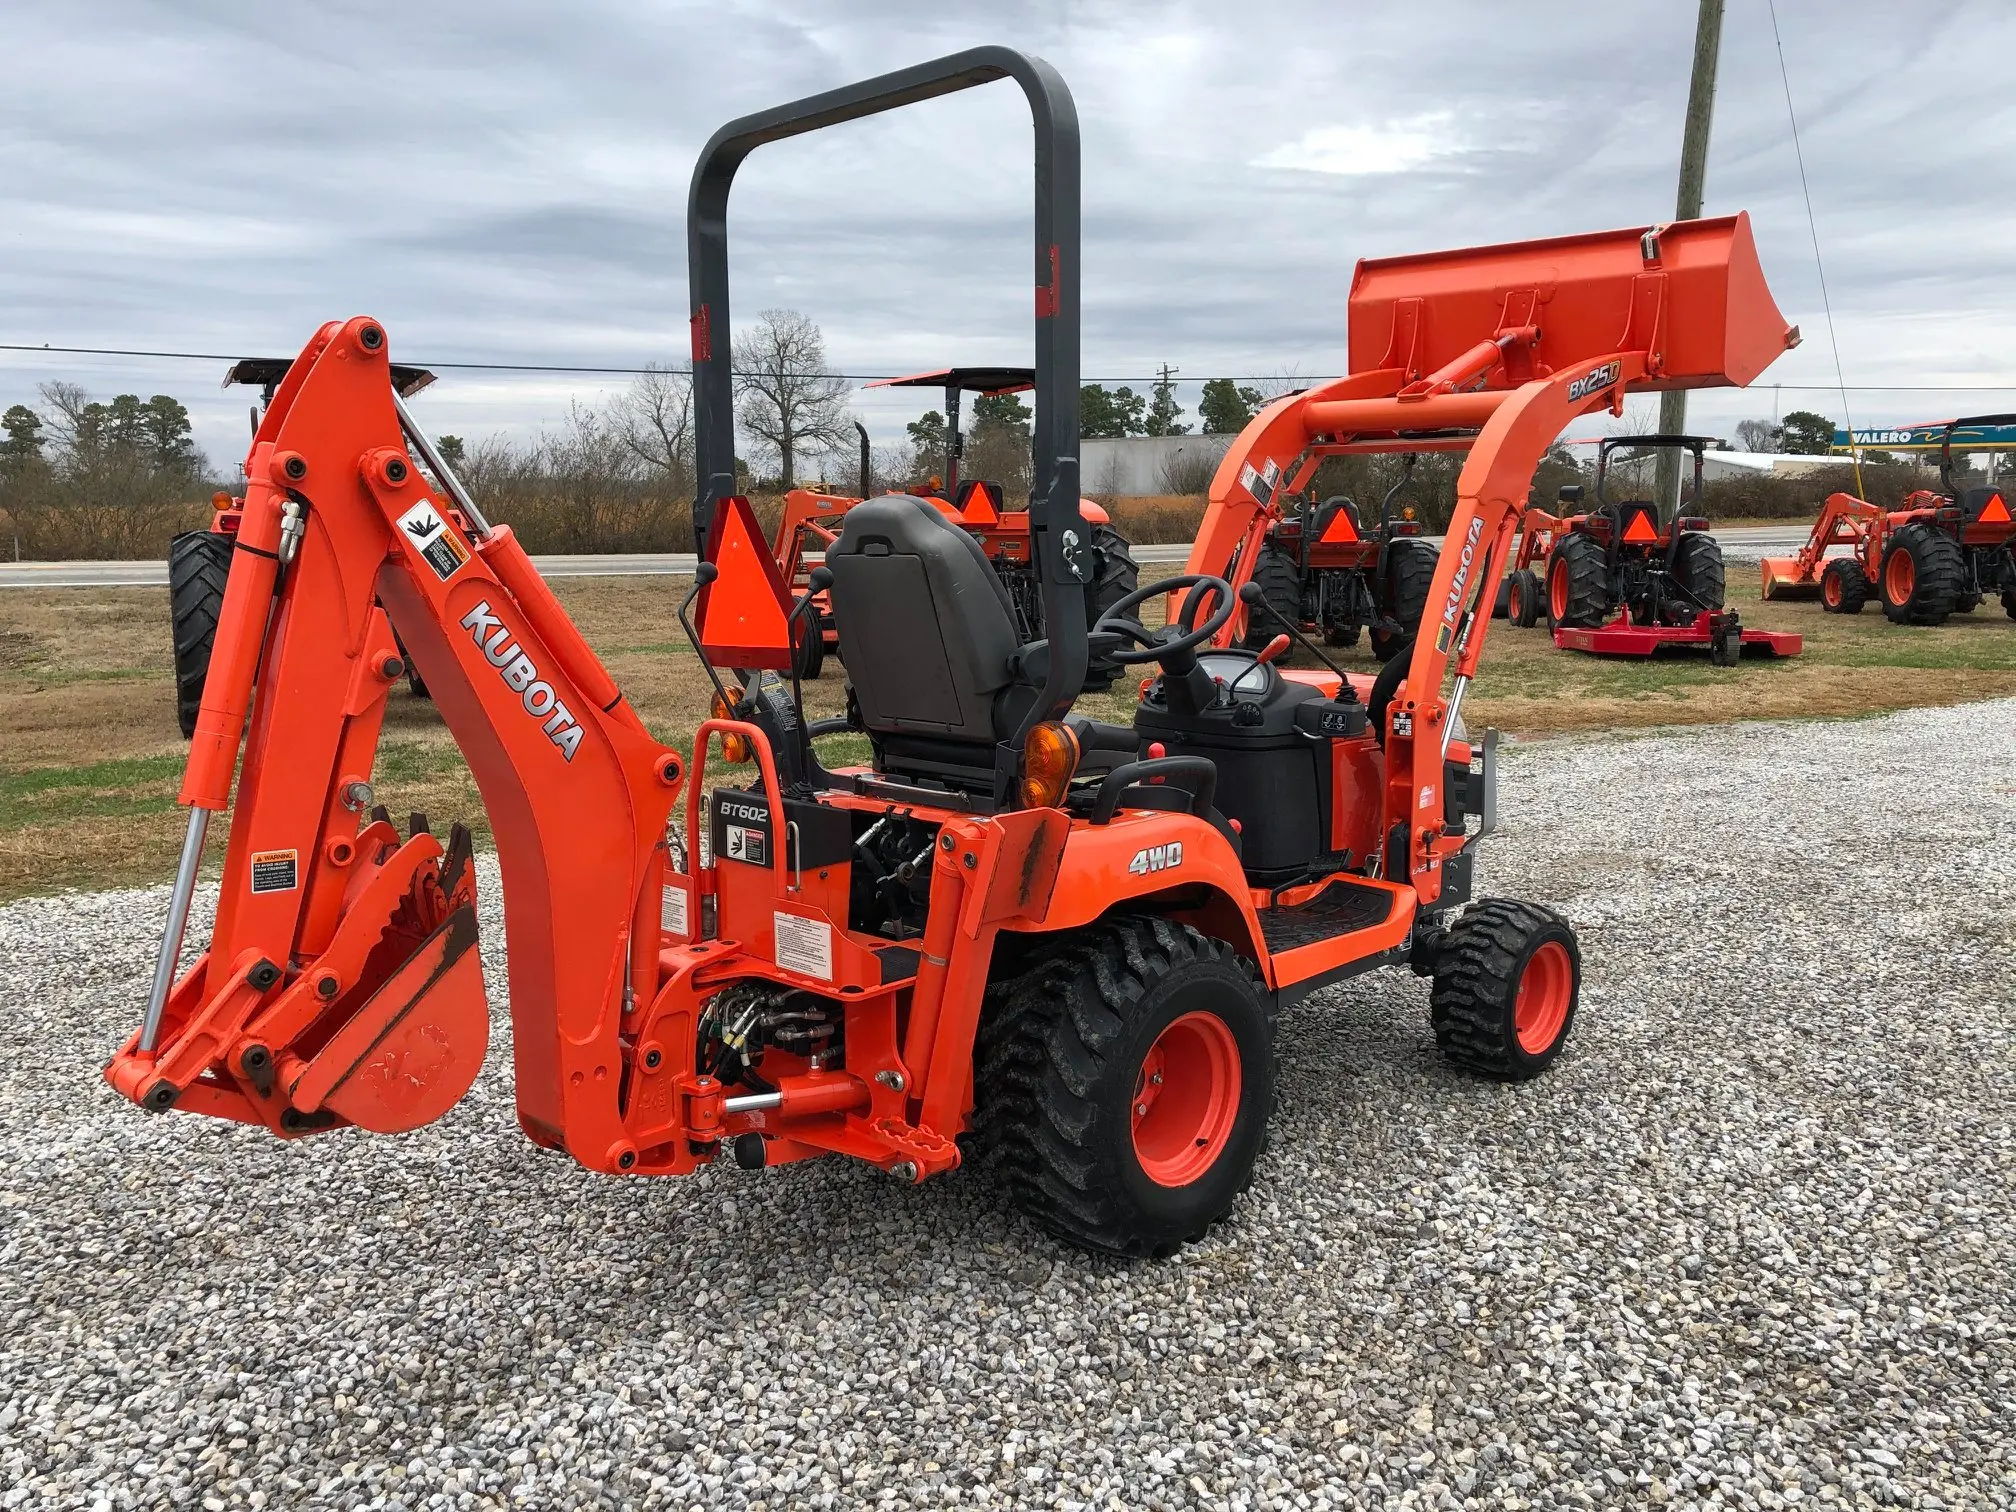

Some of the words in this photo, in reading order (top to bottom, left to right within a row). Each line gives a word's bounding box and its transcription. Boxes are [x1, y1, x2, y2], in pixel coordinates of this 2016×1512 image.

[1568, 360, 1621, 402] BX25D
[1852, 431, 1911, 443] VALERO
[448, 539, 465, 559] WARNING
[1444, 516, 1485, 622] KUBOTA
[459, 600, 585, 763] KUBOTA
[721, 802, 768, 822] BT602
[264, 853, 292, 861] WARNING
[1129, 841, 1183, 876] 4WD
